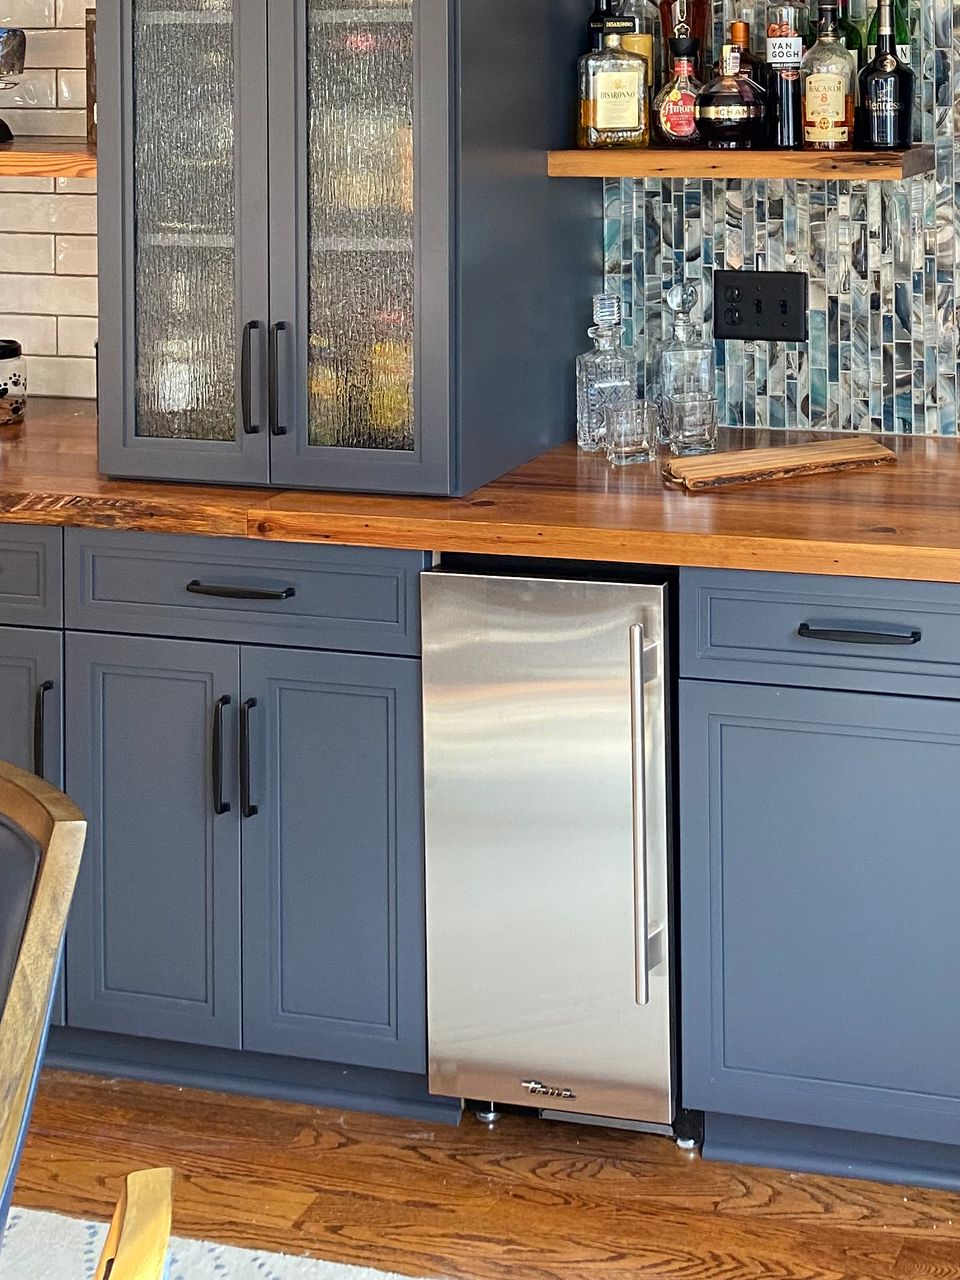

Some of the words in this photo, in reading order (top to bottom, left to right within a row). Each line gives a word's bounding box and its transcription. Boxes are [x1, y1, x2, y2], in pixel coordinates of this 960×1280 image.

[771, 42, 792, 50] VAN
[771, 50, 800, 58] GOGH
[600, 91, 636, 100] DISARONNO
[820, 93, 828, 102] 8
